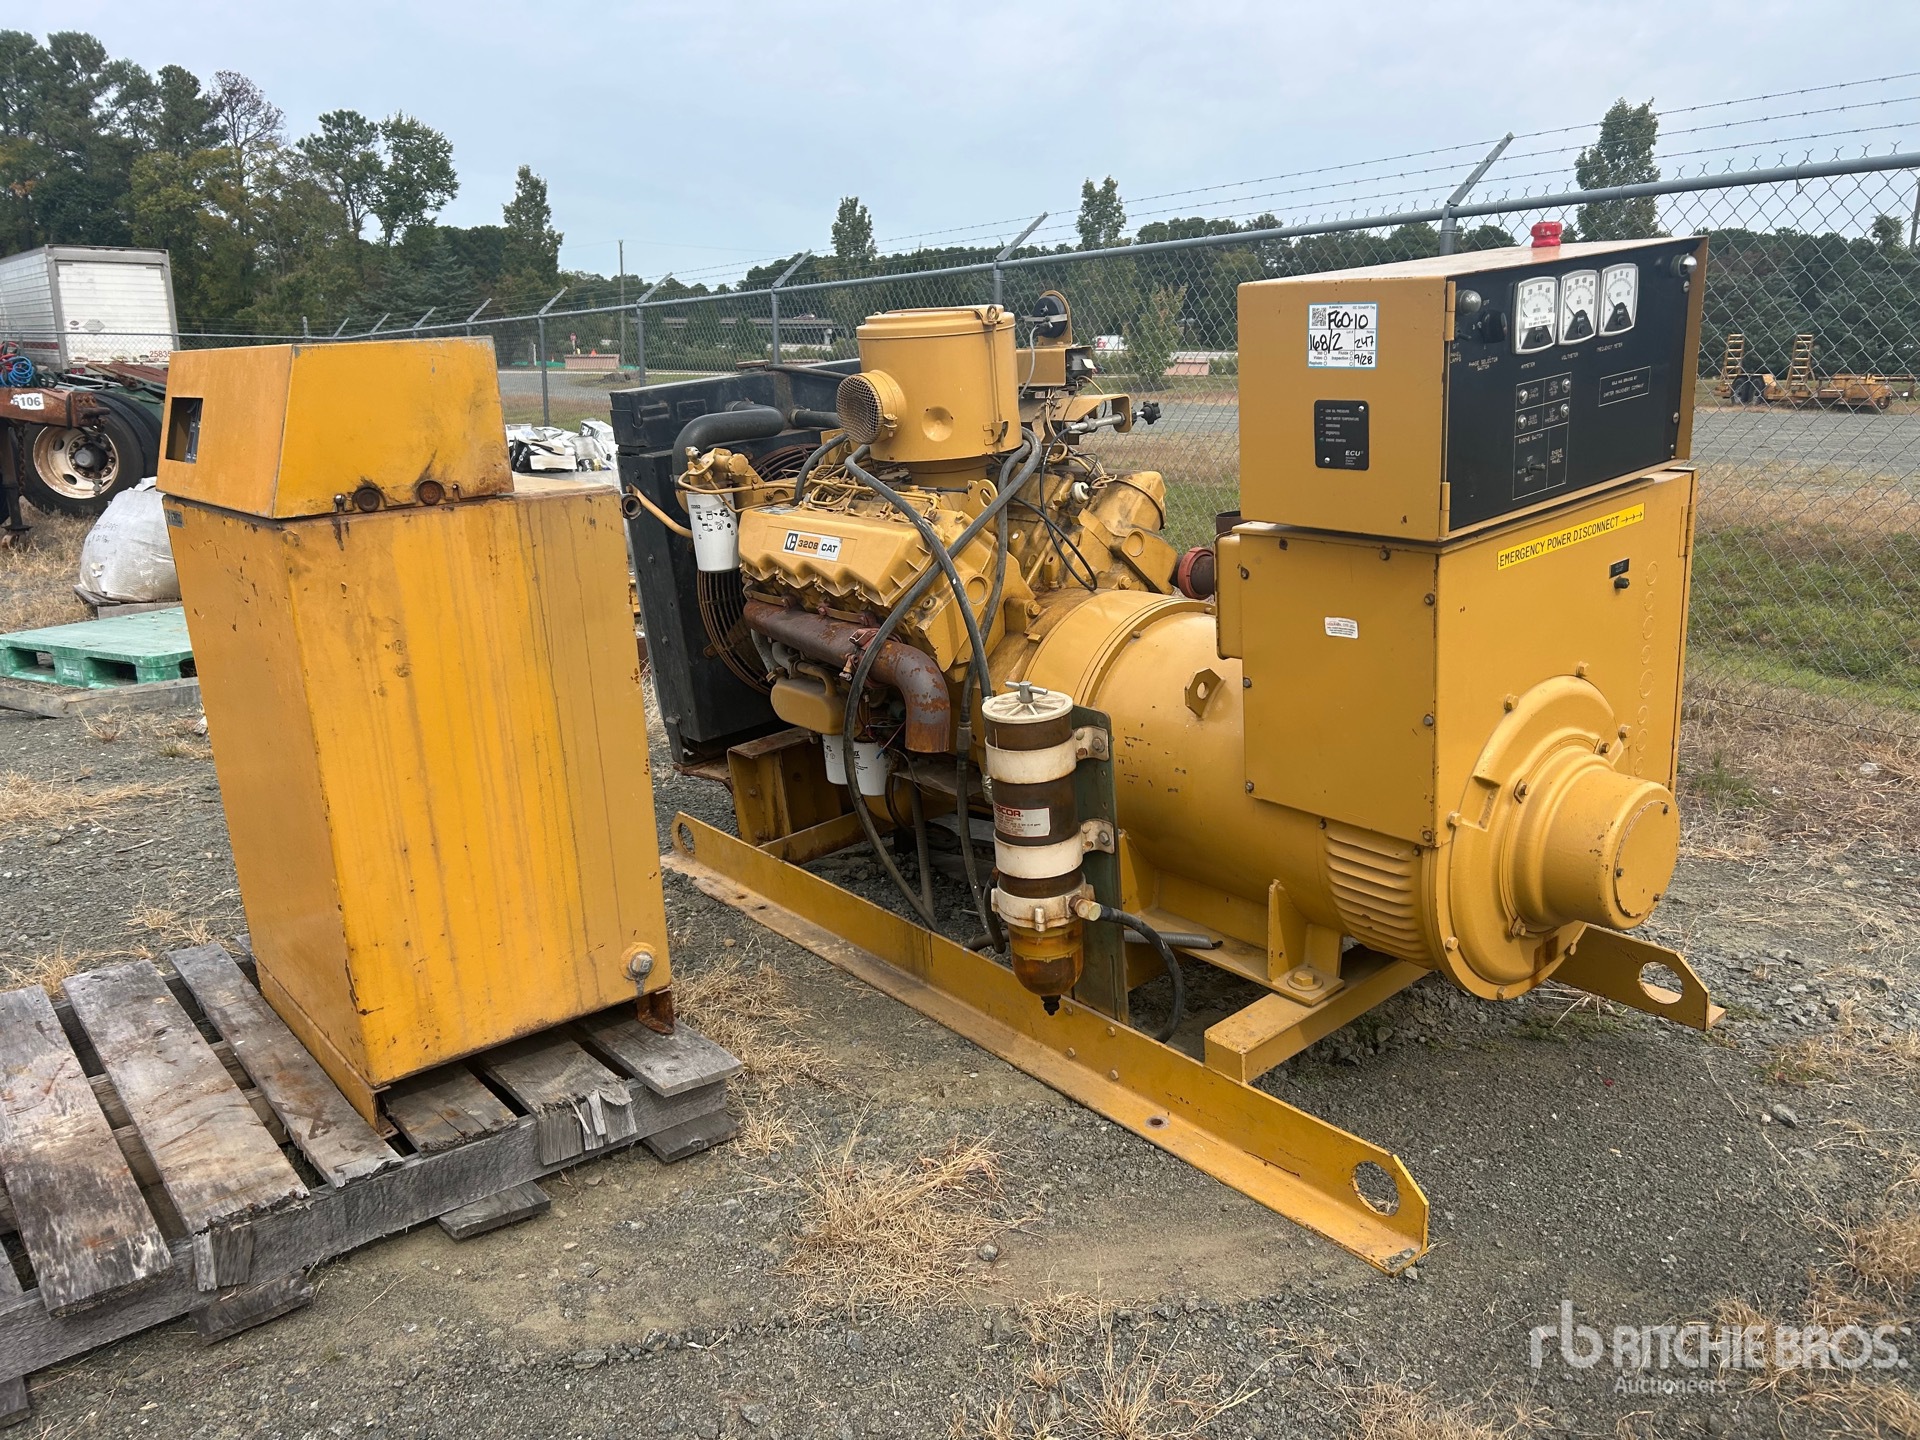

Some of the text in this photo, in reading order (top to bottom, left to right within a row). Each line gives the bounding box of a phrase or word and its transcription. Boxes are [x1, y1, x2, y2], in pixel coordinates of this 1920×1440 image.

[1309, 329, 1343, 354] 168/2
[1354, 335, 1374, 348] 247
[1354, 353, 1373, 365] 9/28
[798, 540, 819, 550] 3208
[821, 543, 838, 553] CAT
[1499, 515, 1620, 567] EMERGENCY POWER DISCONNECT
